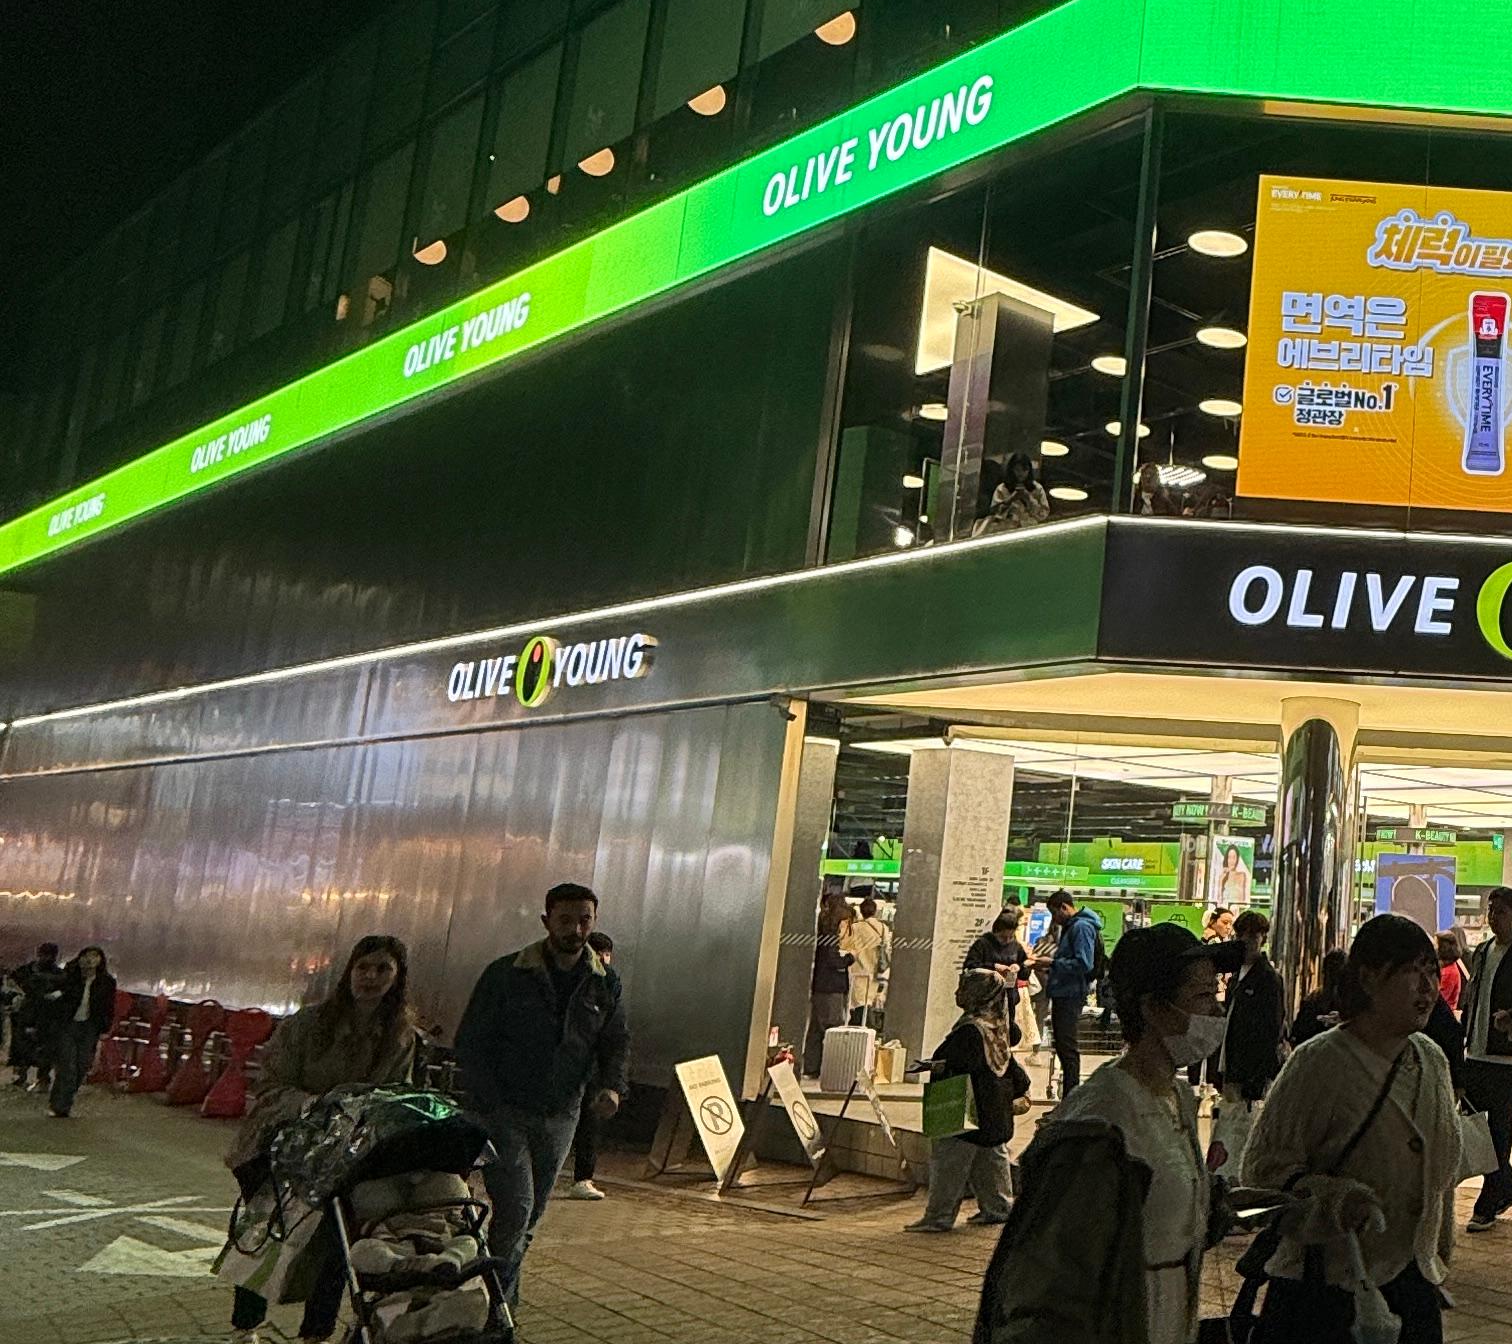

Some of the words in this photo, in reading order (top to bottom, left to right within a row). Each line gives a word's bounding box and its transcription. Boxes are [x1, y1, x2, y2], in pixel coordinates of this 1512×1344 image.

[763, 137, 859, 216] OLIVE
[867, 75, 994, 171] YOUNG
[403, 325, 459, 378] OLIVE
[460, 292, 532, 353] YOUNG
[1281, 290, 1408, 339] 면역은
[1277, 337, 1435, 378] 에브리타임
[191, 435, 227, 473] OLIVE
[226, 413, 272, 457] YOUNG
[1296, 407, 1344, 425] 정관장
[1228, 565, 1460, 635] OLIVE
[447, 654, 517, 702] OLIVE
[553, 633, 650, 687] YOUNG
